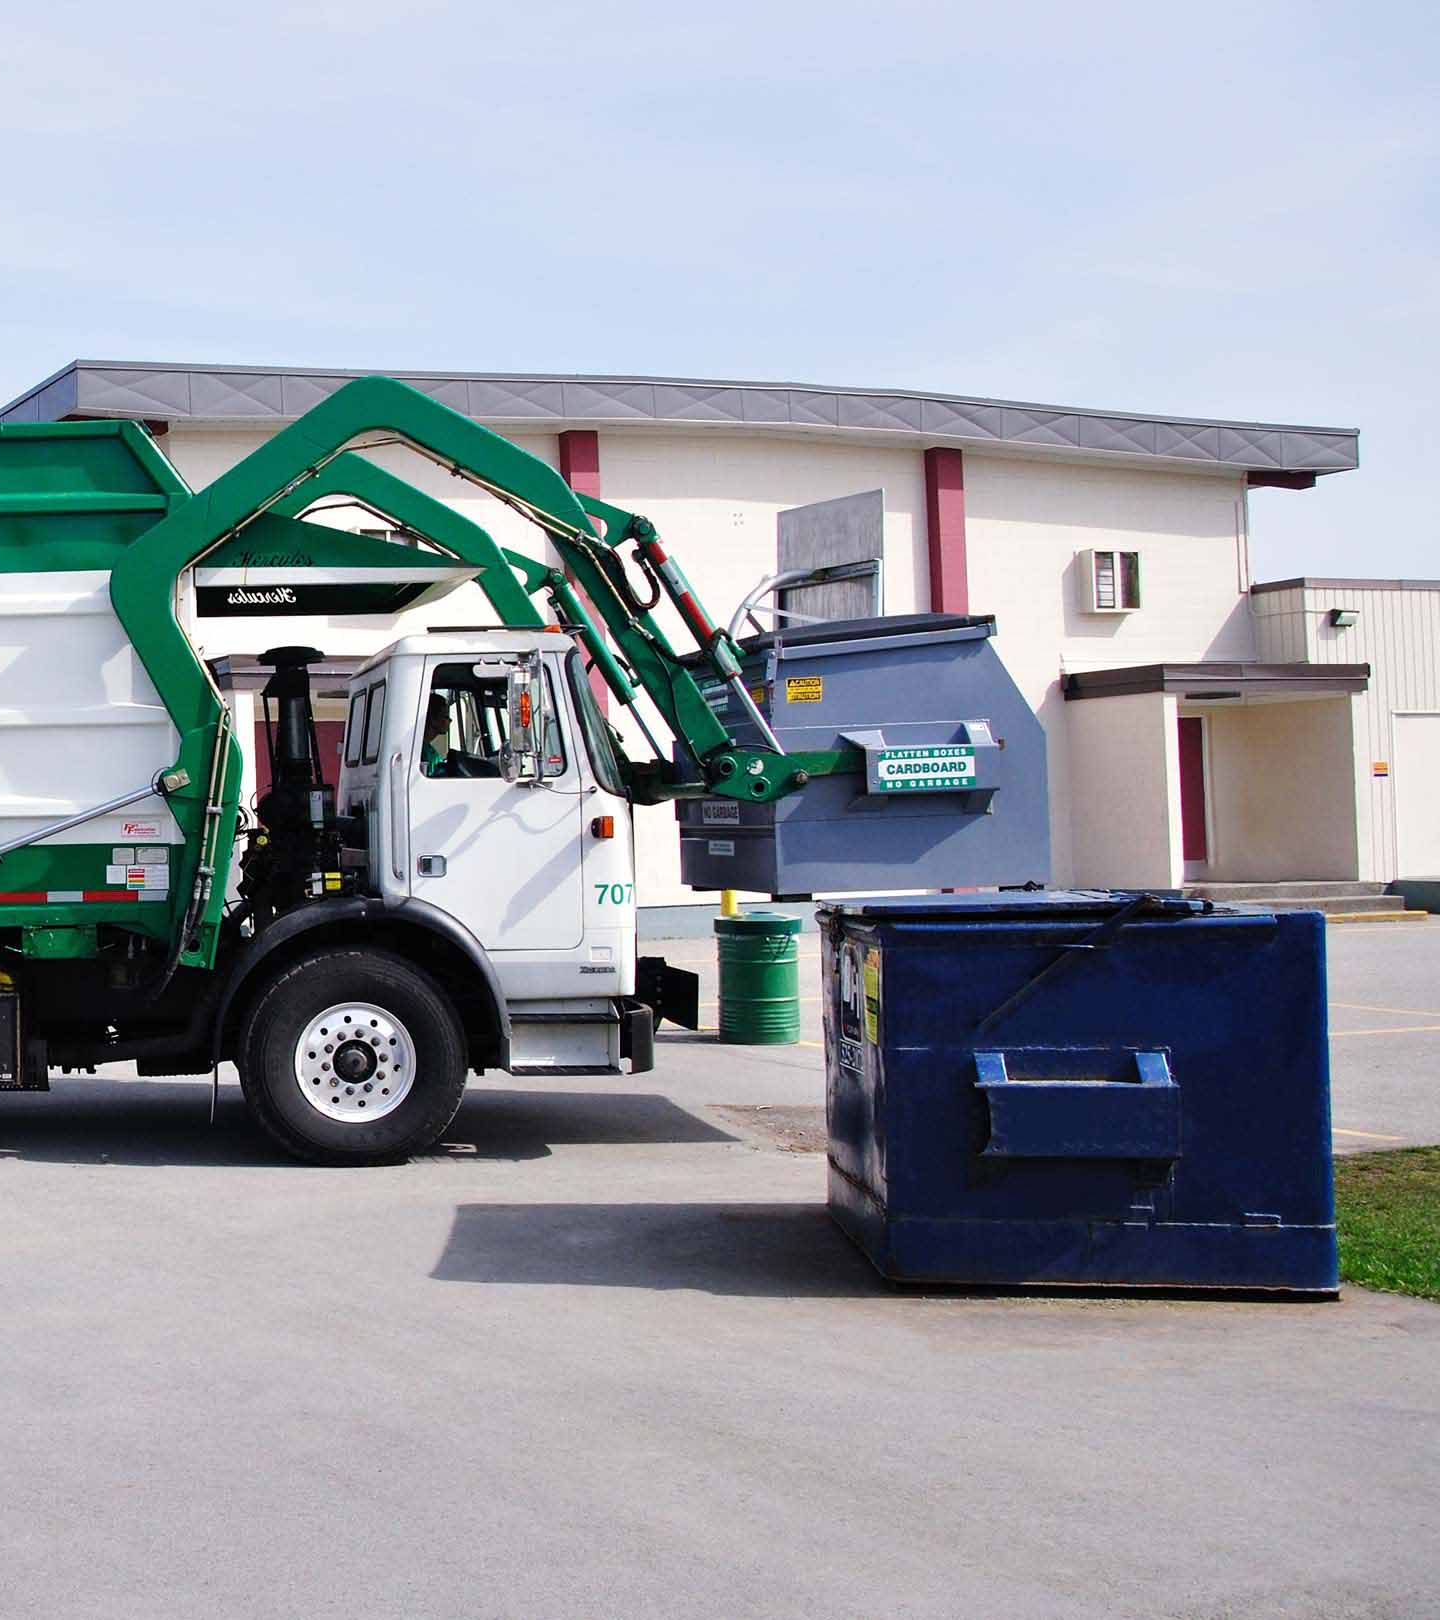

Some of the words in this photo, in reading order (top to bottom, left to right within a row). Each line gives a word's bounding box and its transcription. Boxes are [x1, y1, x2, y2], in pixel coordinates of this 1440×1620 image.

[232, 550, 313, 567] Hercules
[885, 750, 929, 759] FLATTEN
[933, 748, 967, 757] BOXES
[886, 761, 967, 775] CARDBOARD
[886, 781, 902, 789] NO
[910, 778, 969, 787] GARBAGE
[594, 883, 633, 905] 707
